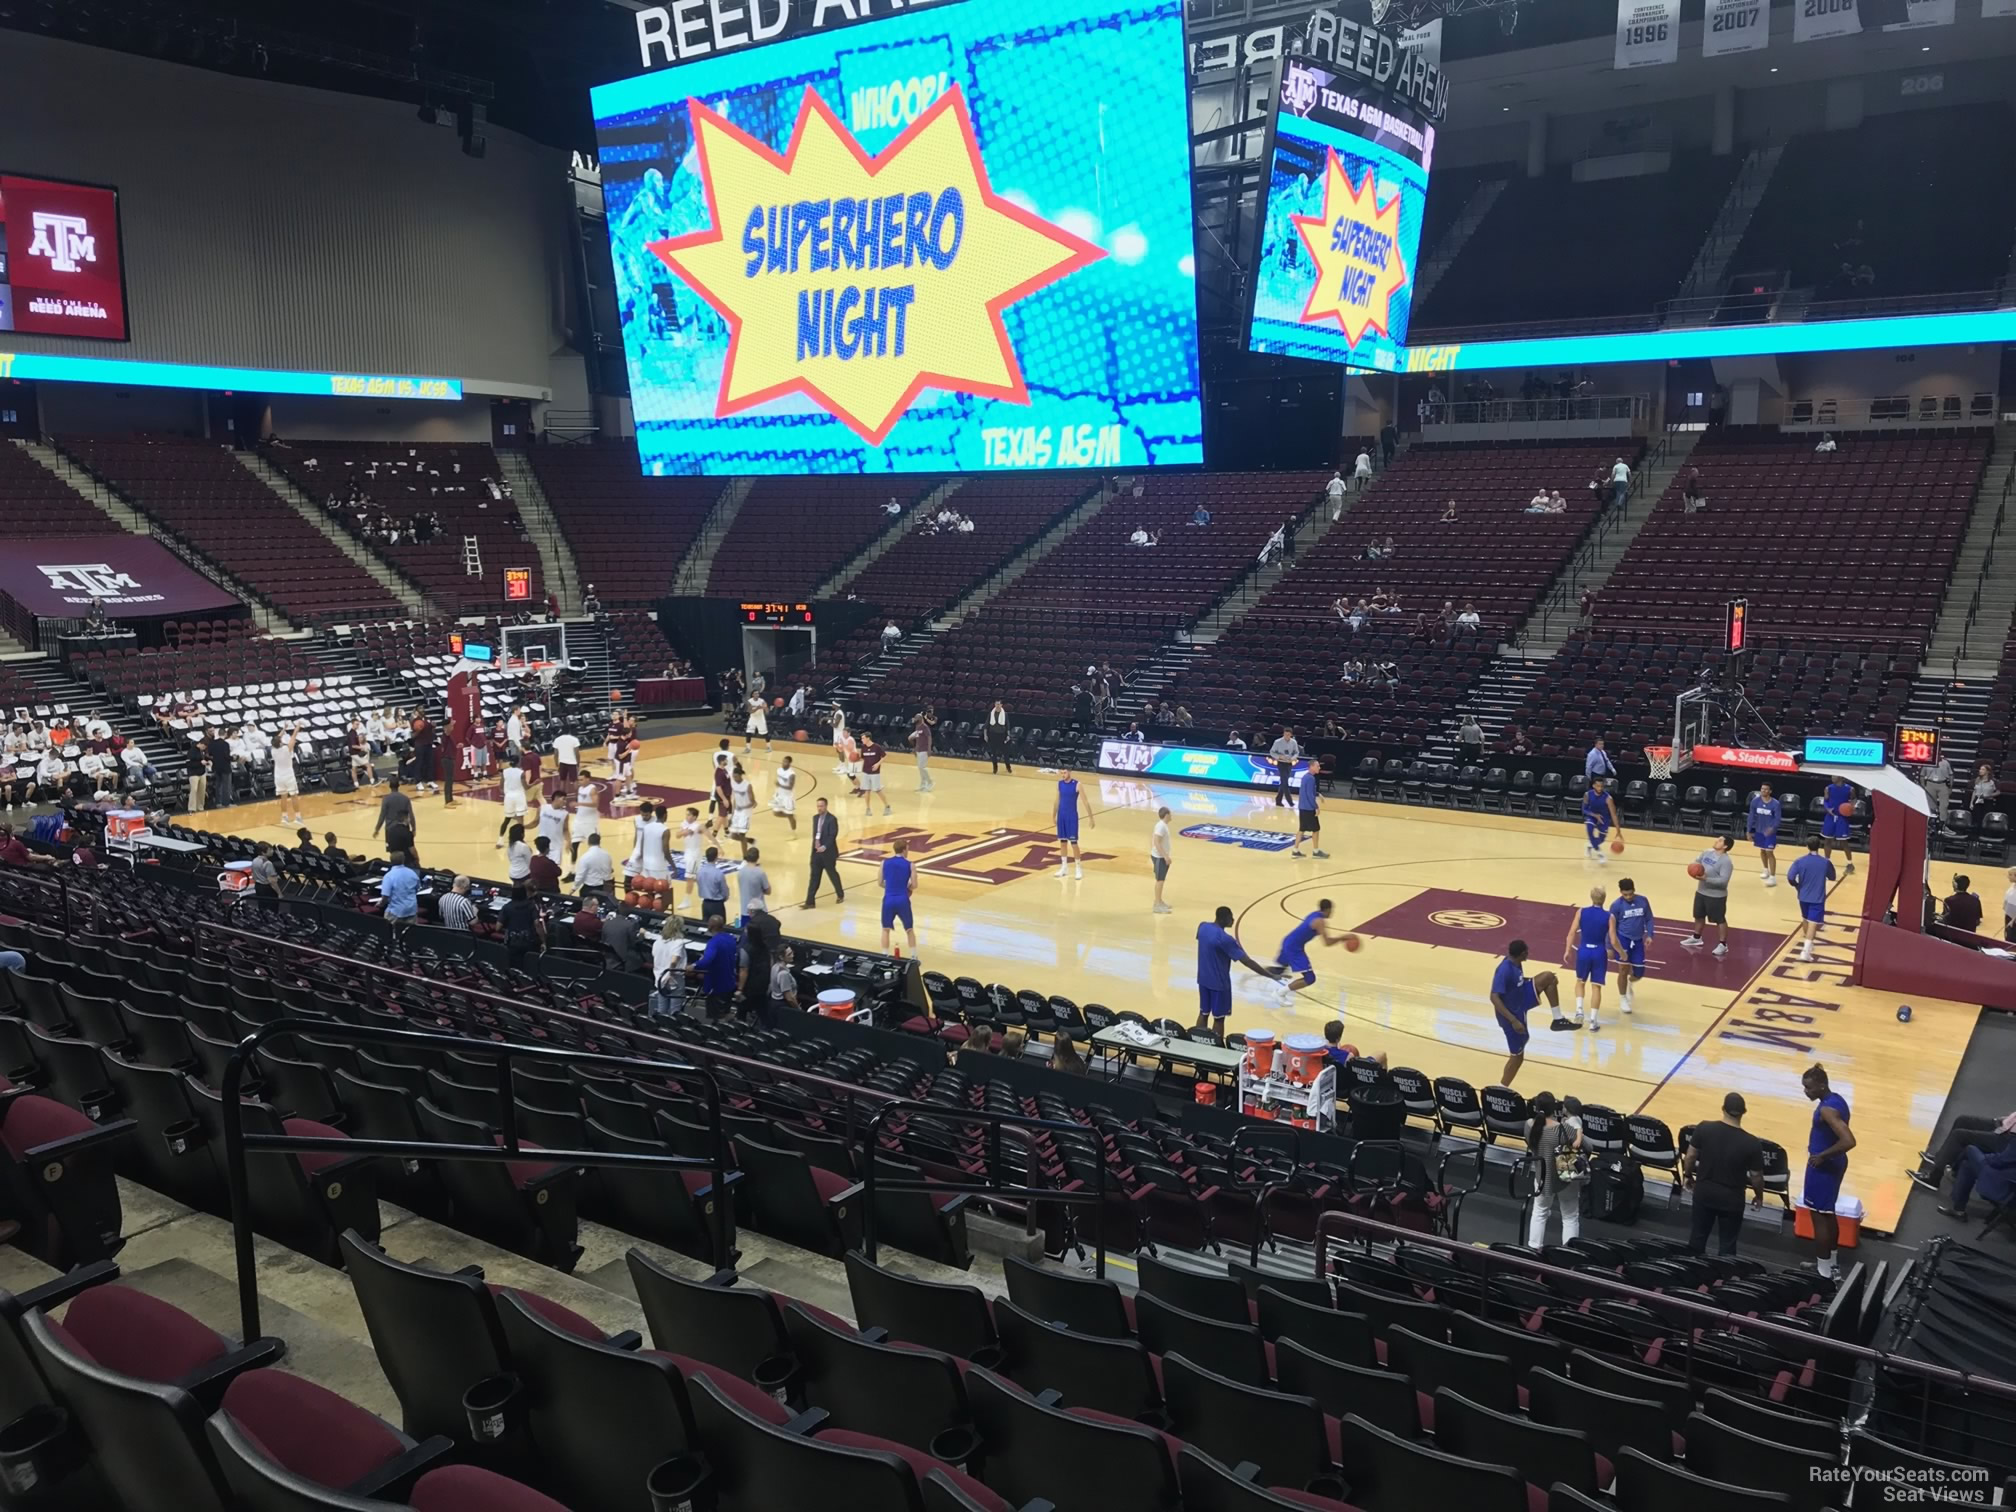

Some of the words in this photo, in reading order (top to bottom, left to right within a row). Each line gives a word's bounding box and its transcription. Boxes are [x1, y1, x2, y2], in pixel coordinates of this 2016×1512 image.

[1628, 14, 1669, 26] CHAMPIONSHIP
[1712, 8, 1760, 33] 2007
[635, 0, 790, 68] REED
[1625, 23, 1668, 46] 1996
[1311, 9, 1394, 83] REED
[1396, 48, 1449, 123] ARENA
[1901, 74, 1945, 95] 206
[1320, 88, 1359, 118] TEXAS
[1359, 103, 1384, 129] A&M
[1383, 113, 1424, 152] BASKETBALL
[742, 186, 964, 279] SUPERHERO
[1330, 214, 1393, 272] SUPERHERO
[1338, 265, 1376, 309] NIGHT
[36, 297, 82, 308] WELCOME
[29, 302, 63, 316] REED
[65, 304, 107, 319] ARENA
[797, 283, 915, 363] NIGHT
[1407, 345, 1461, 373] NIGHT
[331, 376, 366, 394] TEXAS
[367, 378, 395, 396] A&M
[981, 424, 1052, 468] TEXAS
[1056, 423, 1122, 468] A&M
[509, 580, 527, 597] 30
[749, 611, 756, 621] 0
[804, 611, 812, 622] 0
[1901, 730, 1935, 744] 37:41
[1812, 745, 1876, 758] PROGRESSIVE
[1903, 743, 1929, 760] 30
[1086, 1011, 1110, 1023] MUSCLE
[1719, 987, 1840, 1053] A&M
[1191, 1034, 1216, 1045] MUSCLE
[1247, 1047, 1256, 1058] G
[1291, 1056, 1301, 1068] G
[1351, 1066, 1379, 1078] MUSCLE
[1356, 1075, 1375, 1084] MILK
[1393, 1075, 1422, 1088] MUSCLE
[1399, 1085, 1418, 1094] MILK
[1438, 1085, 1468, 1099] MUSCLE
[1444, 1095, 1464, 1104] MILK
[1486, 1094, 1516, 1107] MUSCLE
[1491, 1104, 1512, 1114] MILK
[1302, 1121, 1310, 1130] G
[1582, 1113, 1614, 1127] MUSCLE
[1587, 1122, 1608, 1133] MILK
[1628, 1123, 1661, 1137] MUSCLE
[1634, 1132, 1656, 1144] MILK
